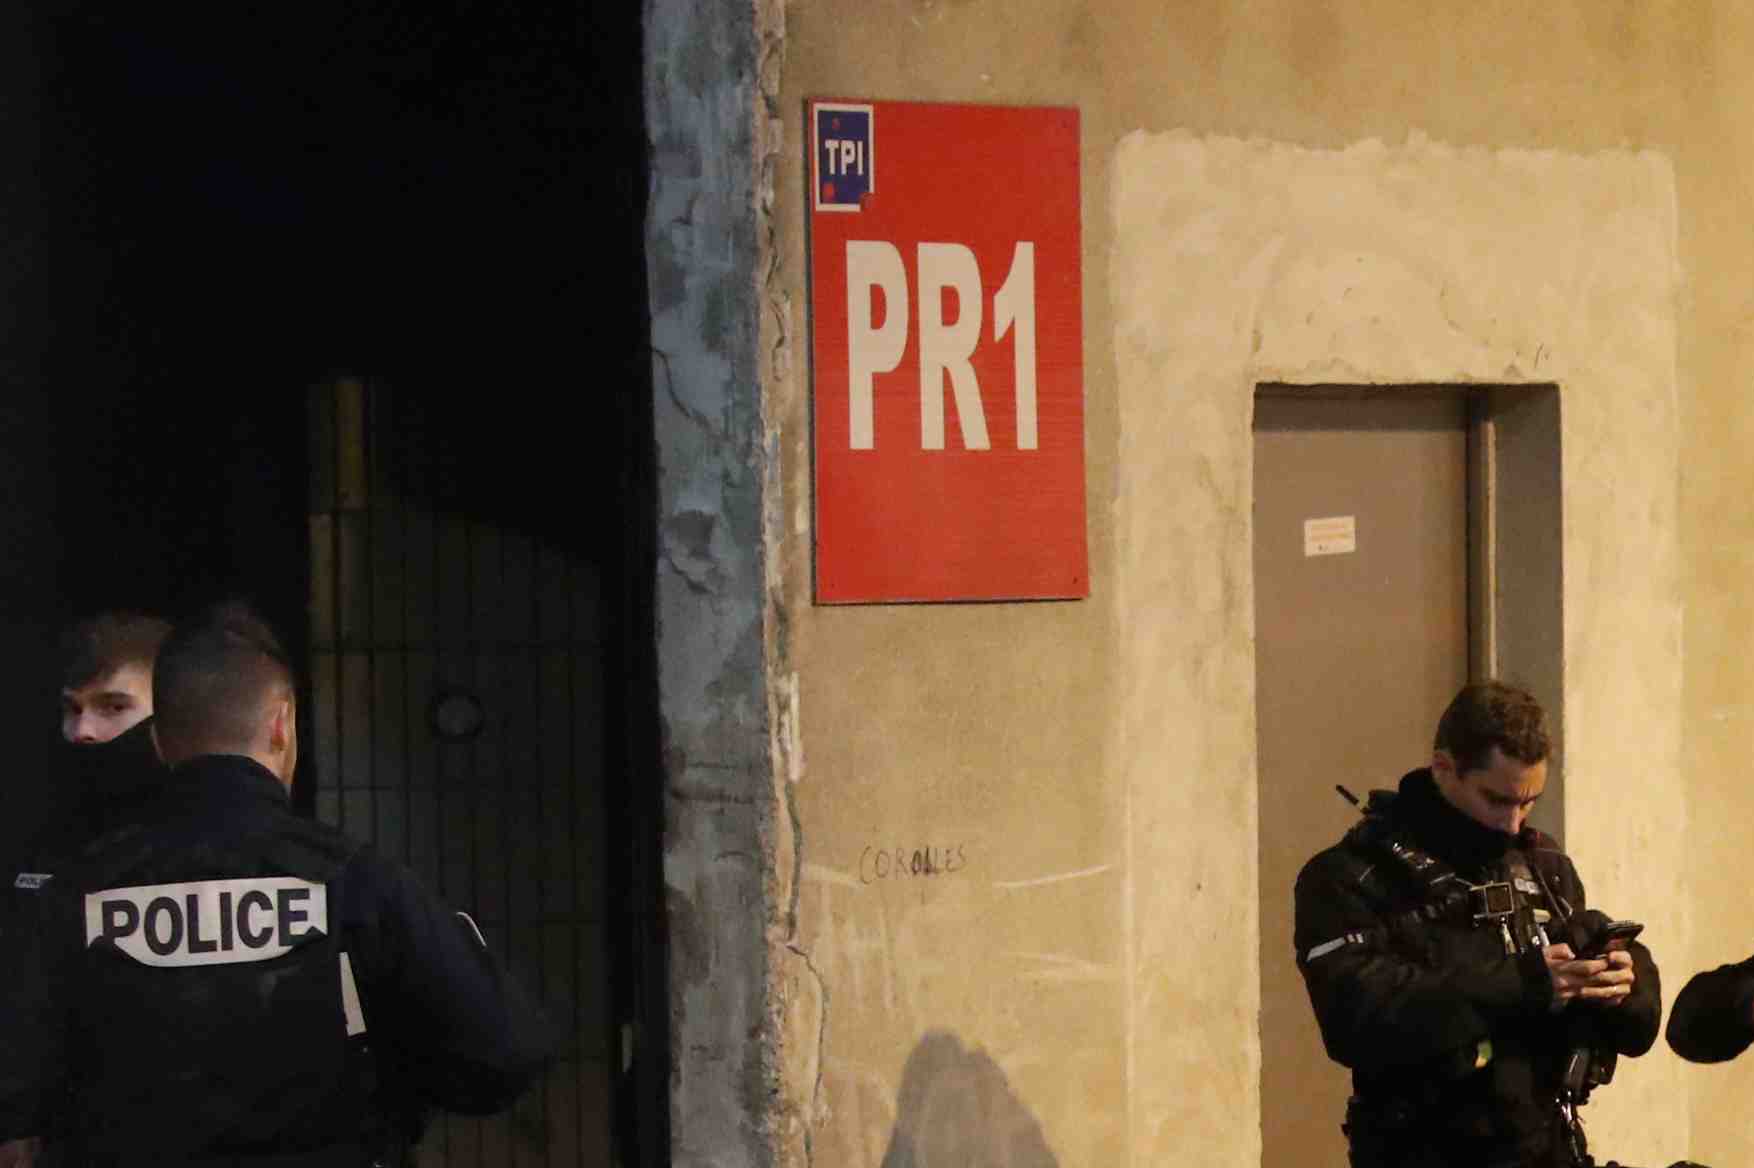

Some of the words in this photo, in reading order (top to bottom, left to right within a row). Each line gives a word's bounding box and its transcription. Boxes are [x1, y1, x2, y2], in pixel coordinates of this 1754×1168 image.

[825, 140, 864, 175] TPI
[846, 240, 1039, 450] PR1
[102, 889, 310, 956] POLICE
